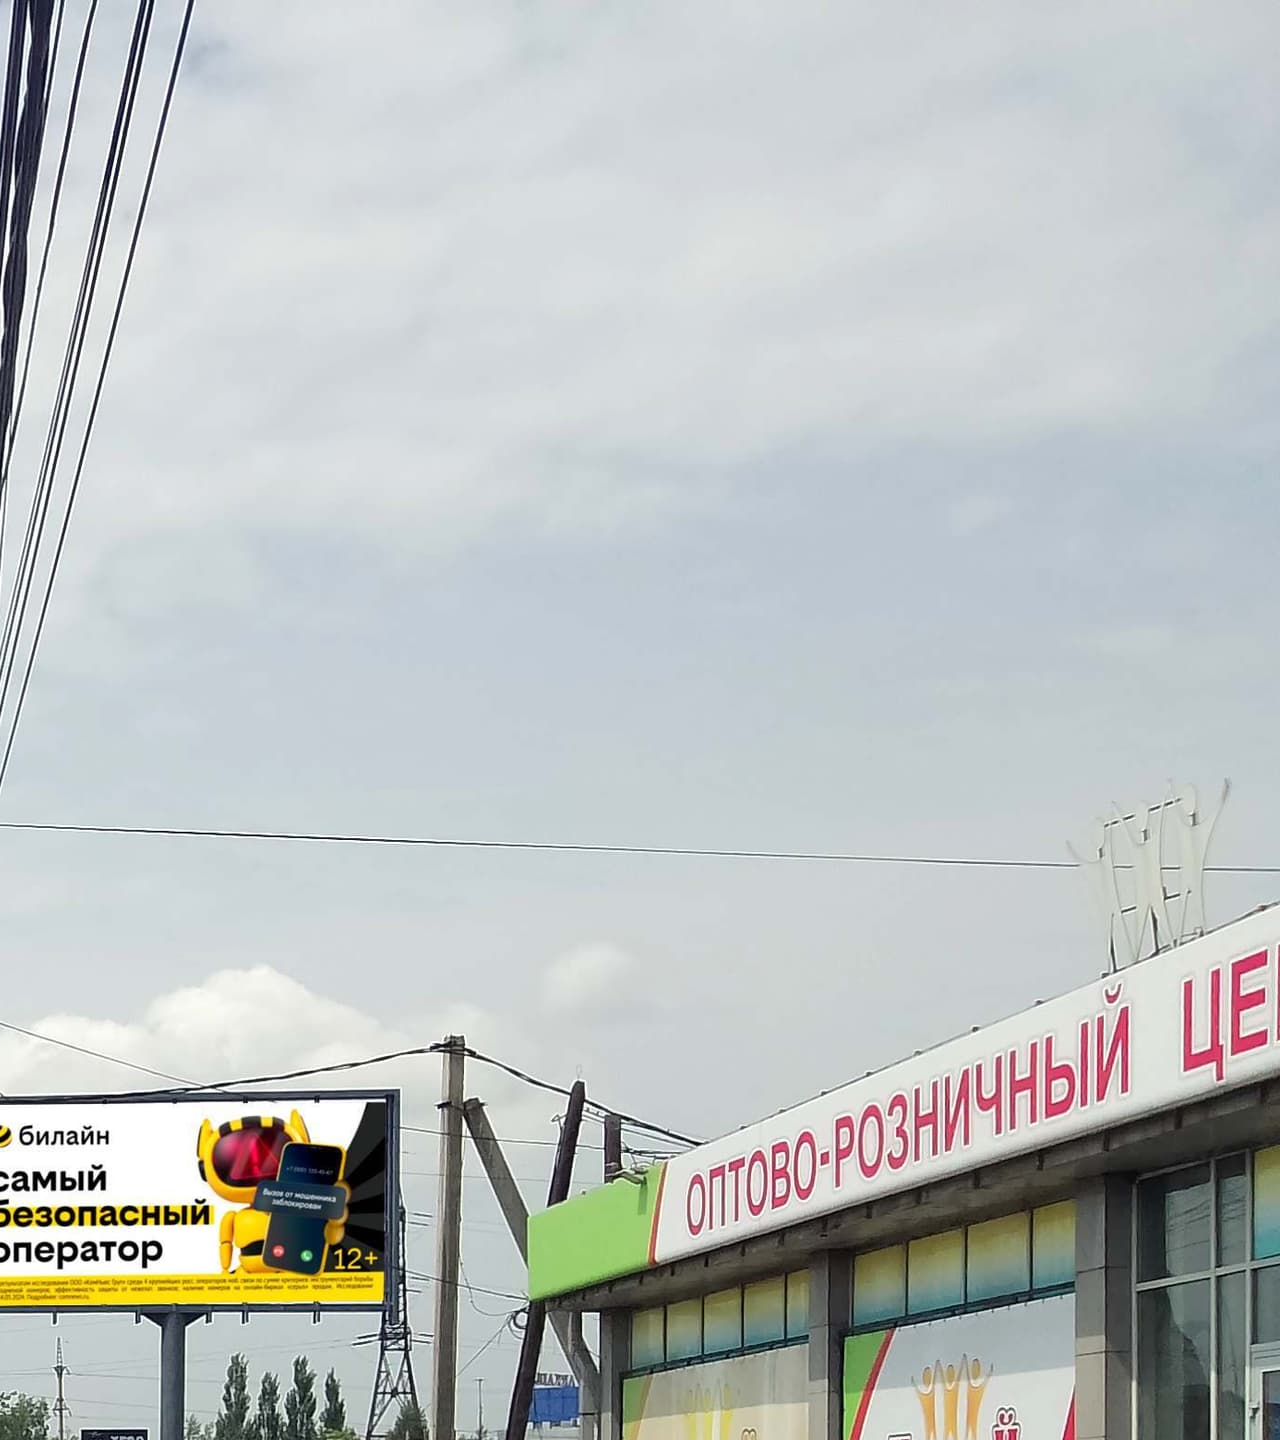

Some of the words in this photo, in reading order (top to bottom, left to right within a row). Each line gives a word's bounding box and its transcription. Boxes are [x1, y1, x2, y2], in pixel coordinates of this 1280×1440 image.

[686, 983, 1130, 1236] ОПТОВО-РОЗНИЧНЫЙ
[1183, 943, 1280, 1082] ЦЕ
[20, 1125, 110, 1146] билайн
[272, 1199, 322, 1210] заблокирован
[295, 1192, 337, 1203] мошенника
[334, 1248, 378, 1270] 12+
